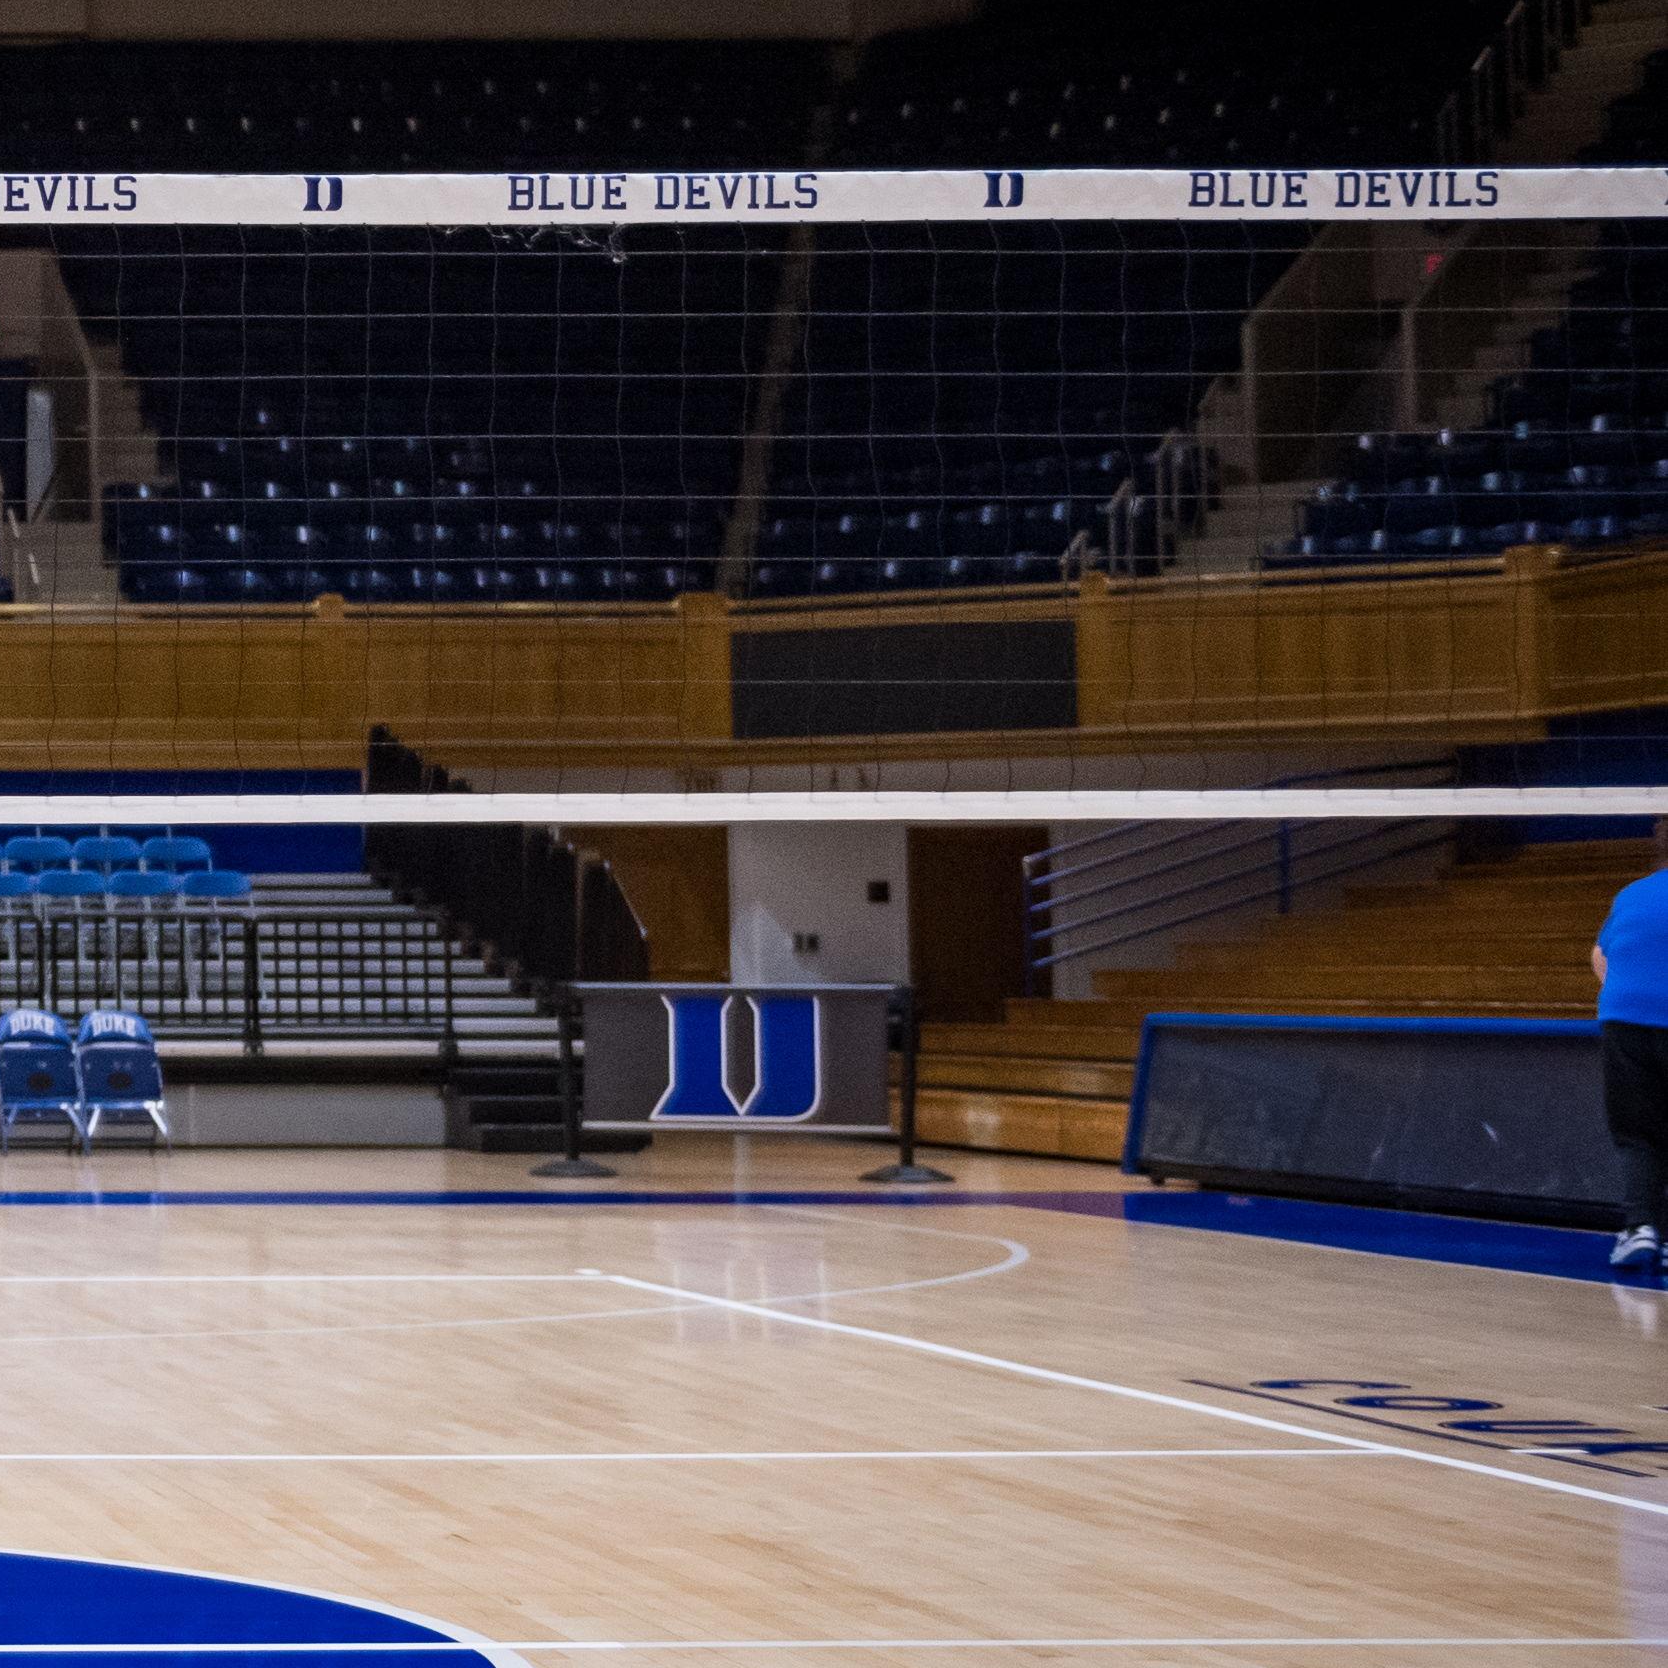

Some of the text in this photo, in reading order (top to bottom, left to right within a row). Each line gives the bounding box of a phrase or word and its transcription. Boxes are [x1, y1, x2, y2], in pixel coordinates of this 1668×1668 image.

[508, 174, 819, 211] BLUE DEVILS
[1188, 171, 1500, 208] BLUE DEVILS
